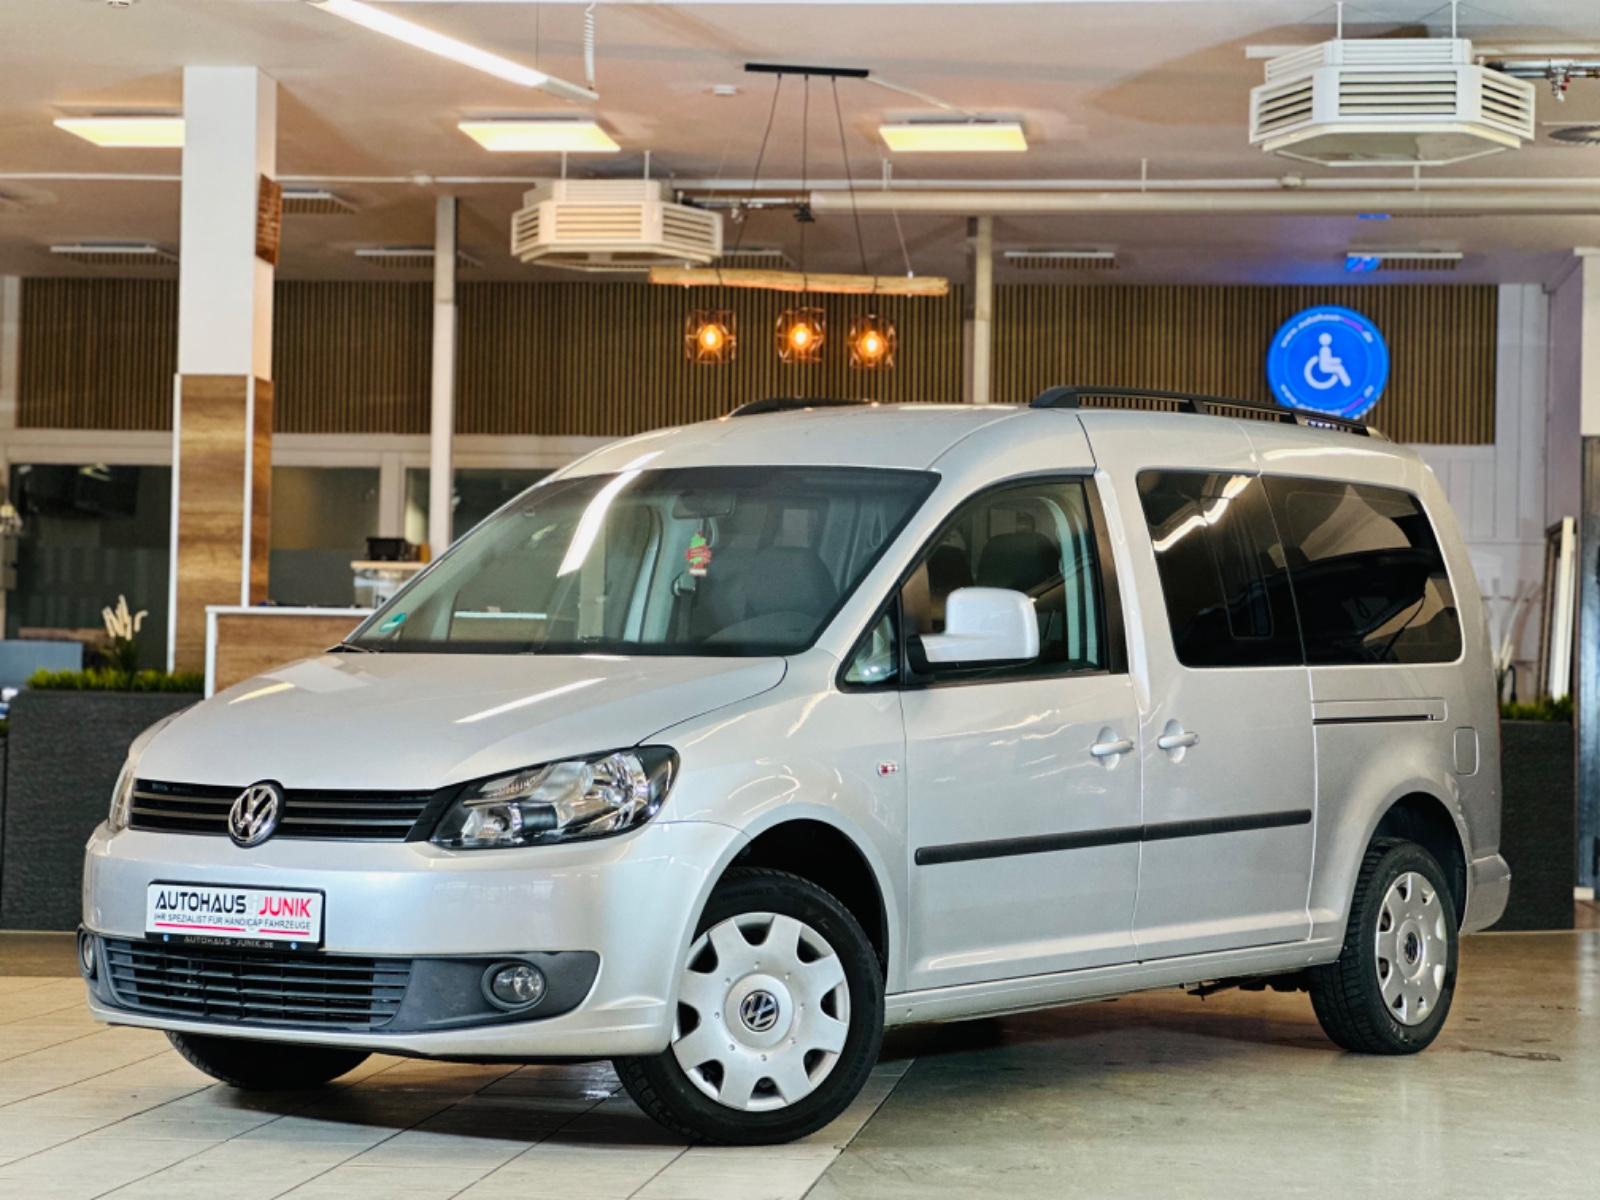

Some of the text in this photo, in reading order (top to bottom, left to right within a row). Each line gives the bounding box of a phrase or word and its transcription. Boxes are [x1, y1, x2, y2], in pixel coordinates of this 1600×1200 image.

[155, 890, 312, 918] AUTOHAUS JUNIK
[168, 914, 207, 924] SPEZIALIST
[224, 917, 263, 927] HANDICAP
[264, 919, 311, 930] FAHRZEUGE
